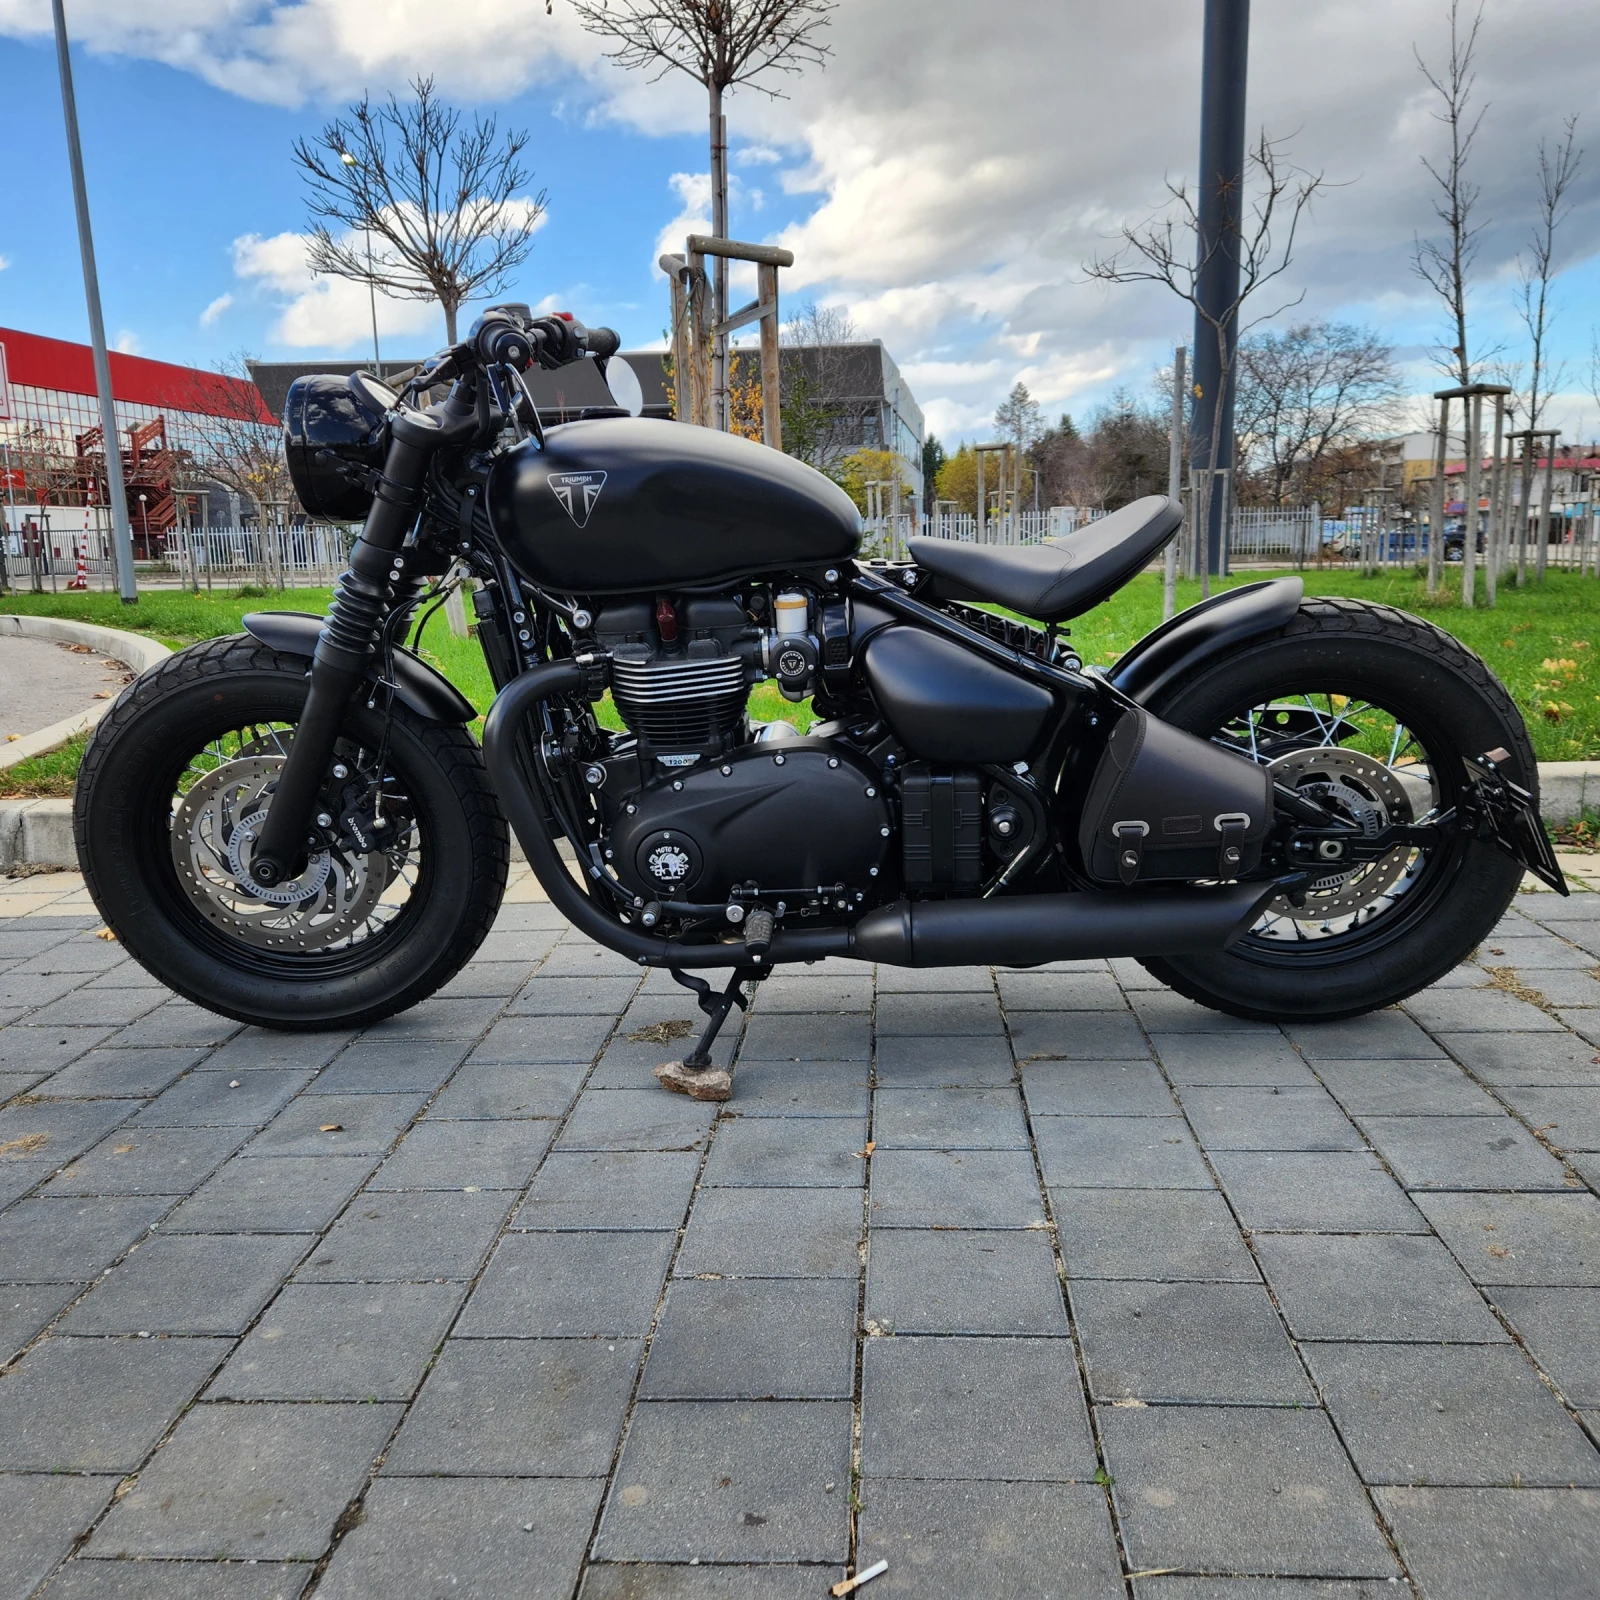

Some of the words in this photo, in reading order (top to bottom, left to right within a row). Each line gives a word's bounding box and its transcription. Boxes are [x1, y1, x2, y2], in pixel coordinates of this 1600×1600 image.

[560, 475, 592, 485] TRIUMPH
[347, 816, 367, 848] brembo
[655, 846, 673, 855] MOTO
